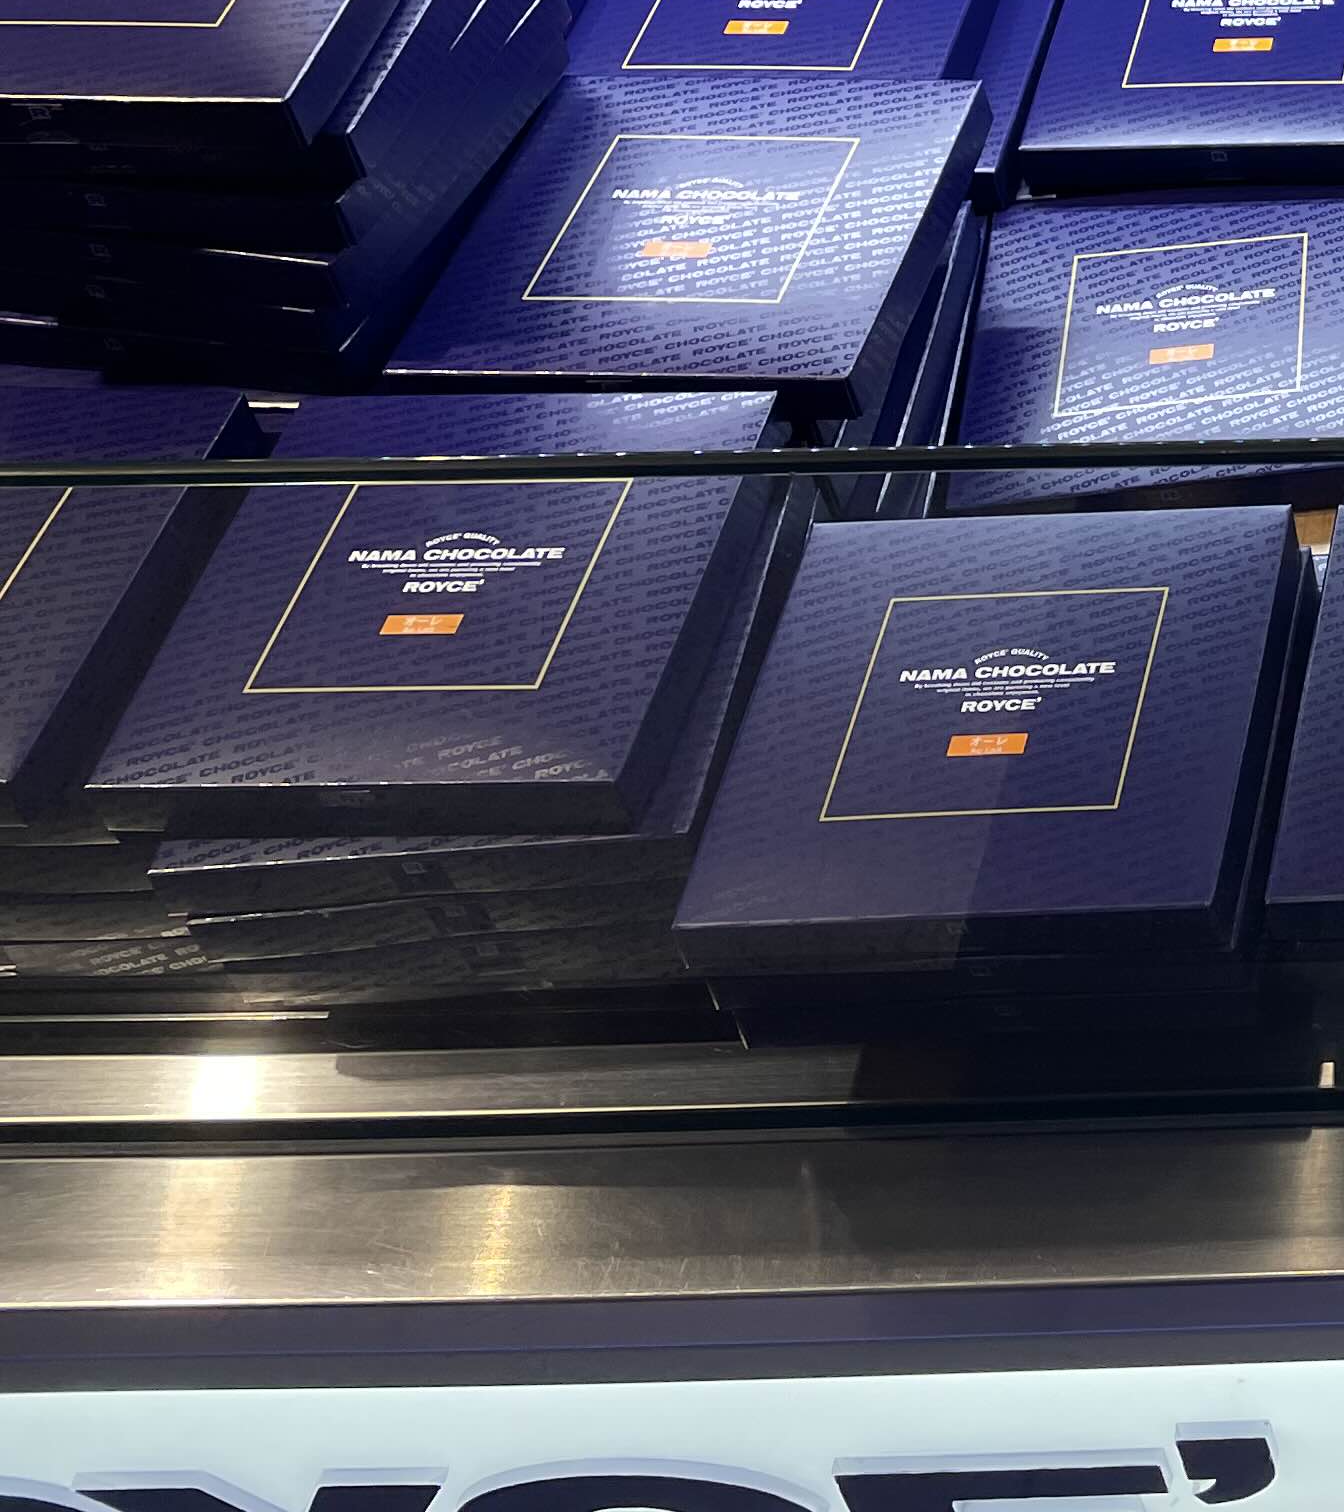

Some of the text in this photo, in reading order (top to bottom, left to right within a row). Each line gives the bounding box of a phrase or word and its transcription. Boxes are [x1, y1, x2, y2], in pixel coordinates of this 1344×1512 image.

[738, 0, 802, 9] ROYCE'
[1220, 17, 1281, 27] ROYCE'
[612, 189, 800, 201] NAMA CHOCOLATE
[1096, 288, 1275, 314] NAMA CHOCOLATE
[1154, 317, 1220, 333] ROYCE'
[348, 547, 566, 562] NAMA CHOCOLATE
[402, 579, 485, 593] ROYCE'
[900, 661, 1117, 682] NAMA CHOCOLATE
[960, 696, 1042, 713] ROYCE'
